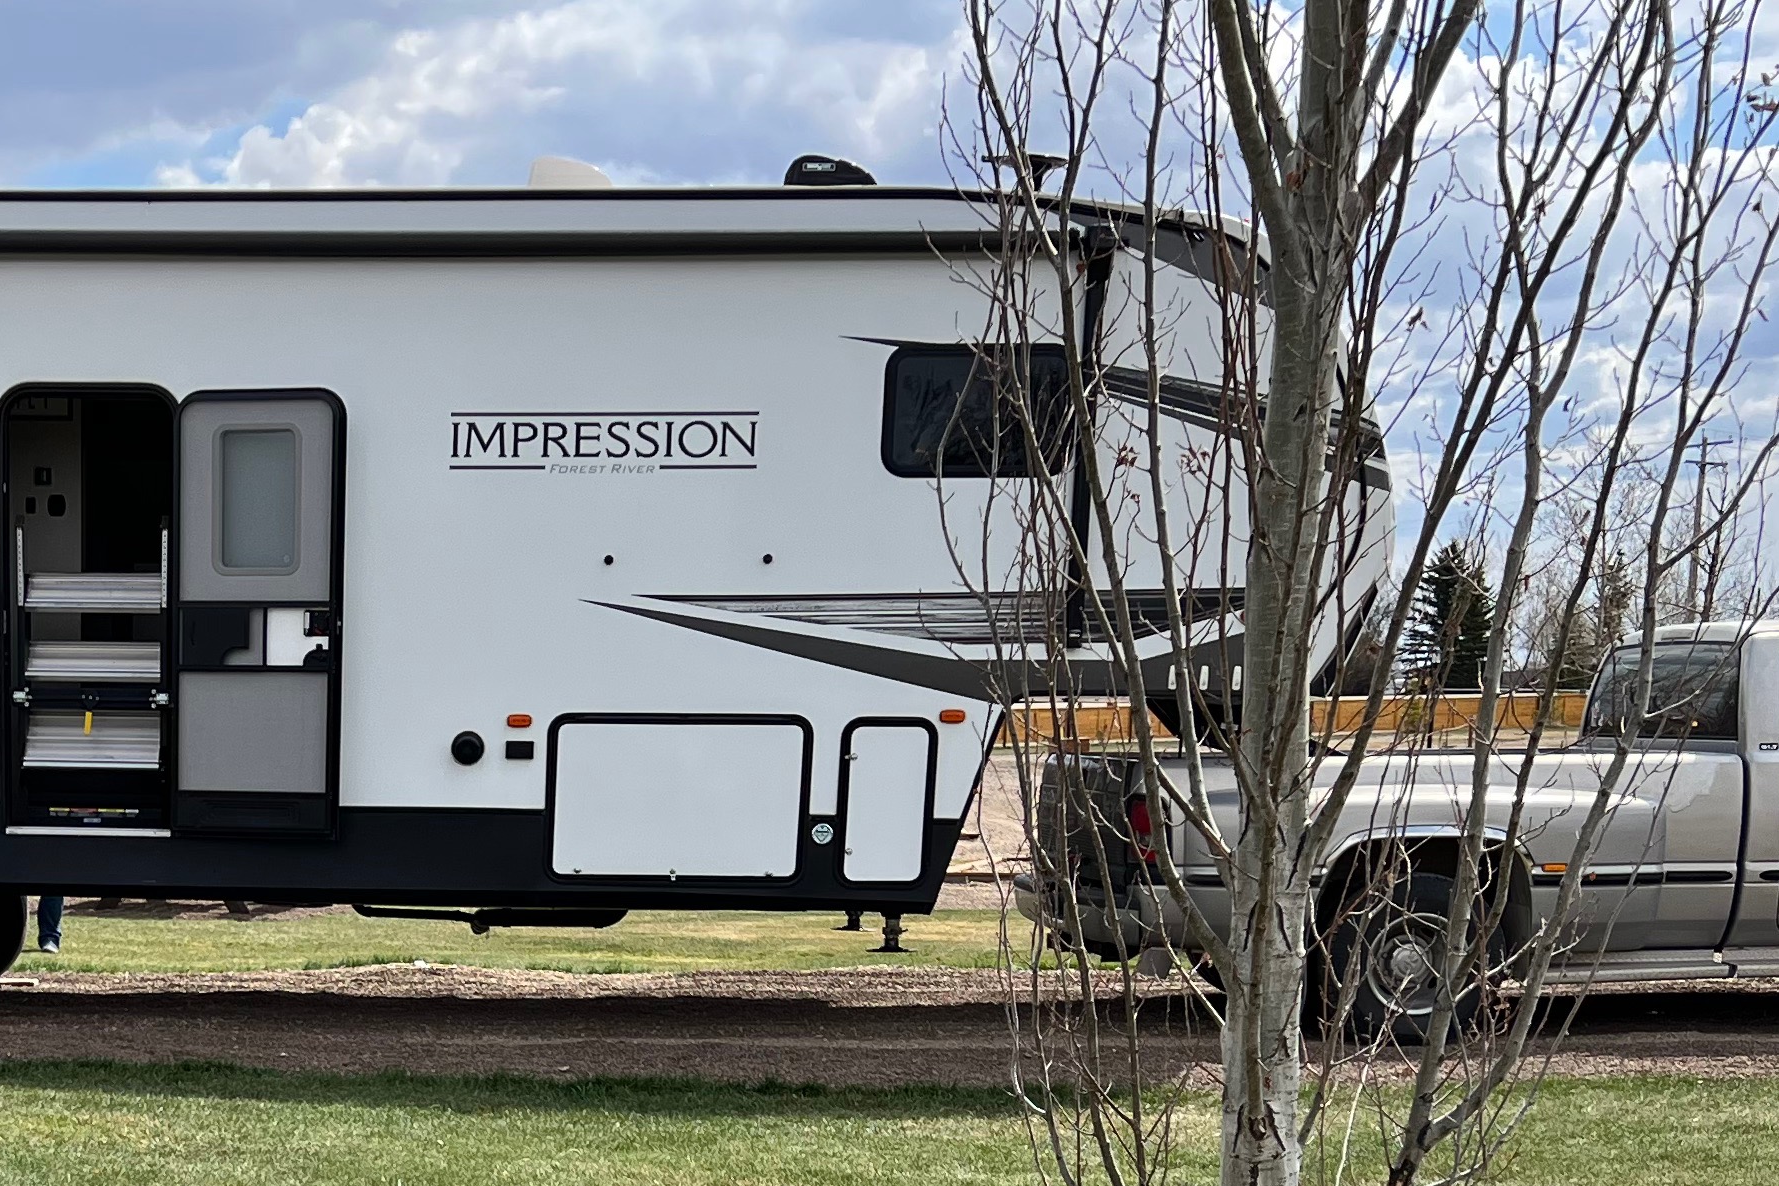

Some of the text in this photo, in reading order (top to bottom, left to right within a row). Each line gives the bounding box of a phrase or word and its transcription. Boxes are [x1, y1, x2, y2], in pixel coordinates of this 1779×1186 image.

[450, 420, 758, 458] IMPRESSION
[549, 463, 656, 474] FOREST RIVER
